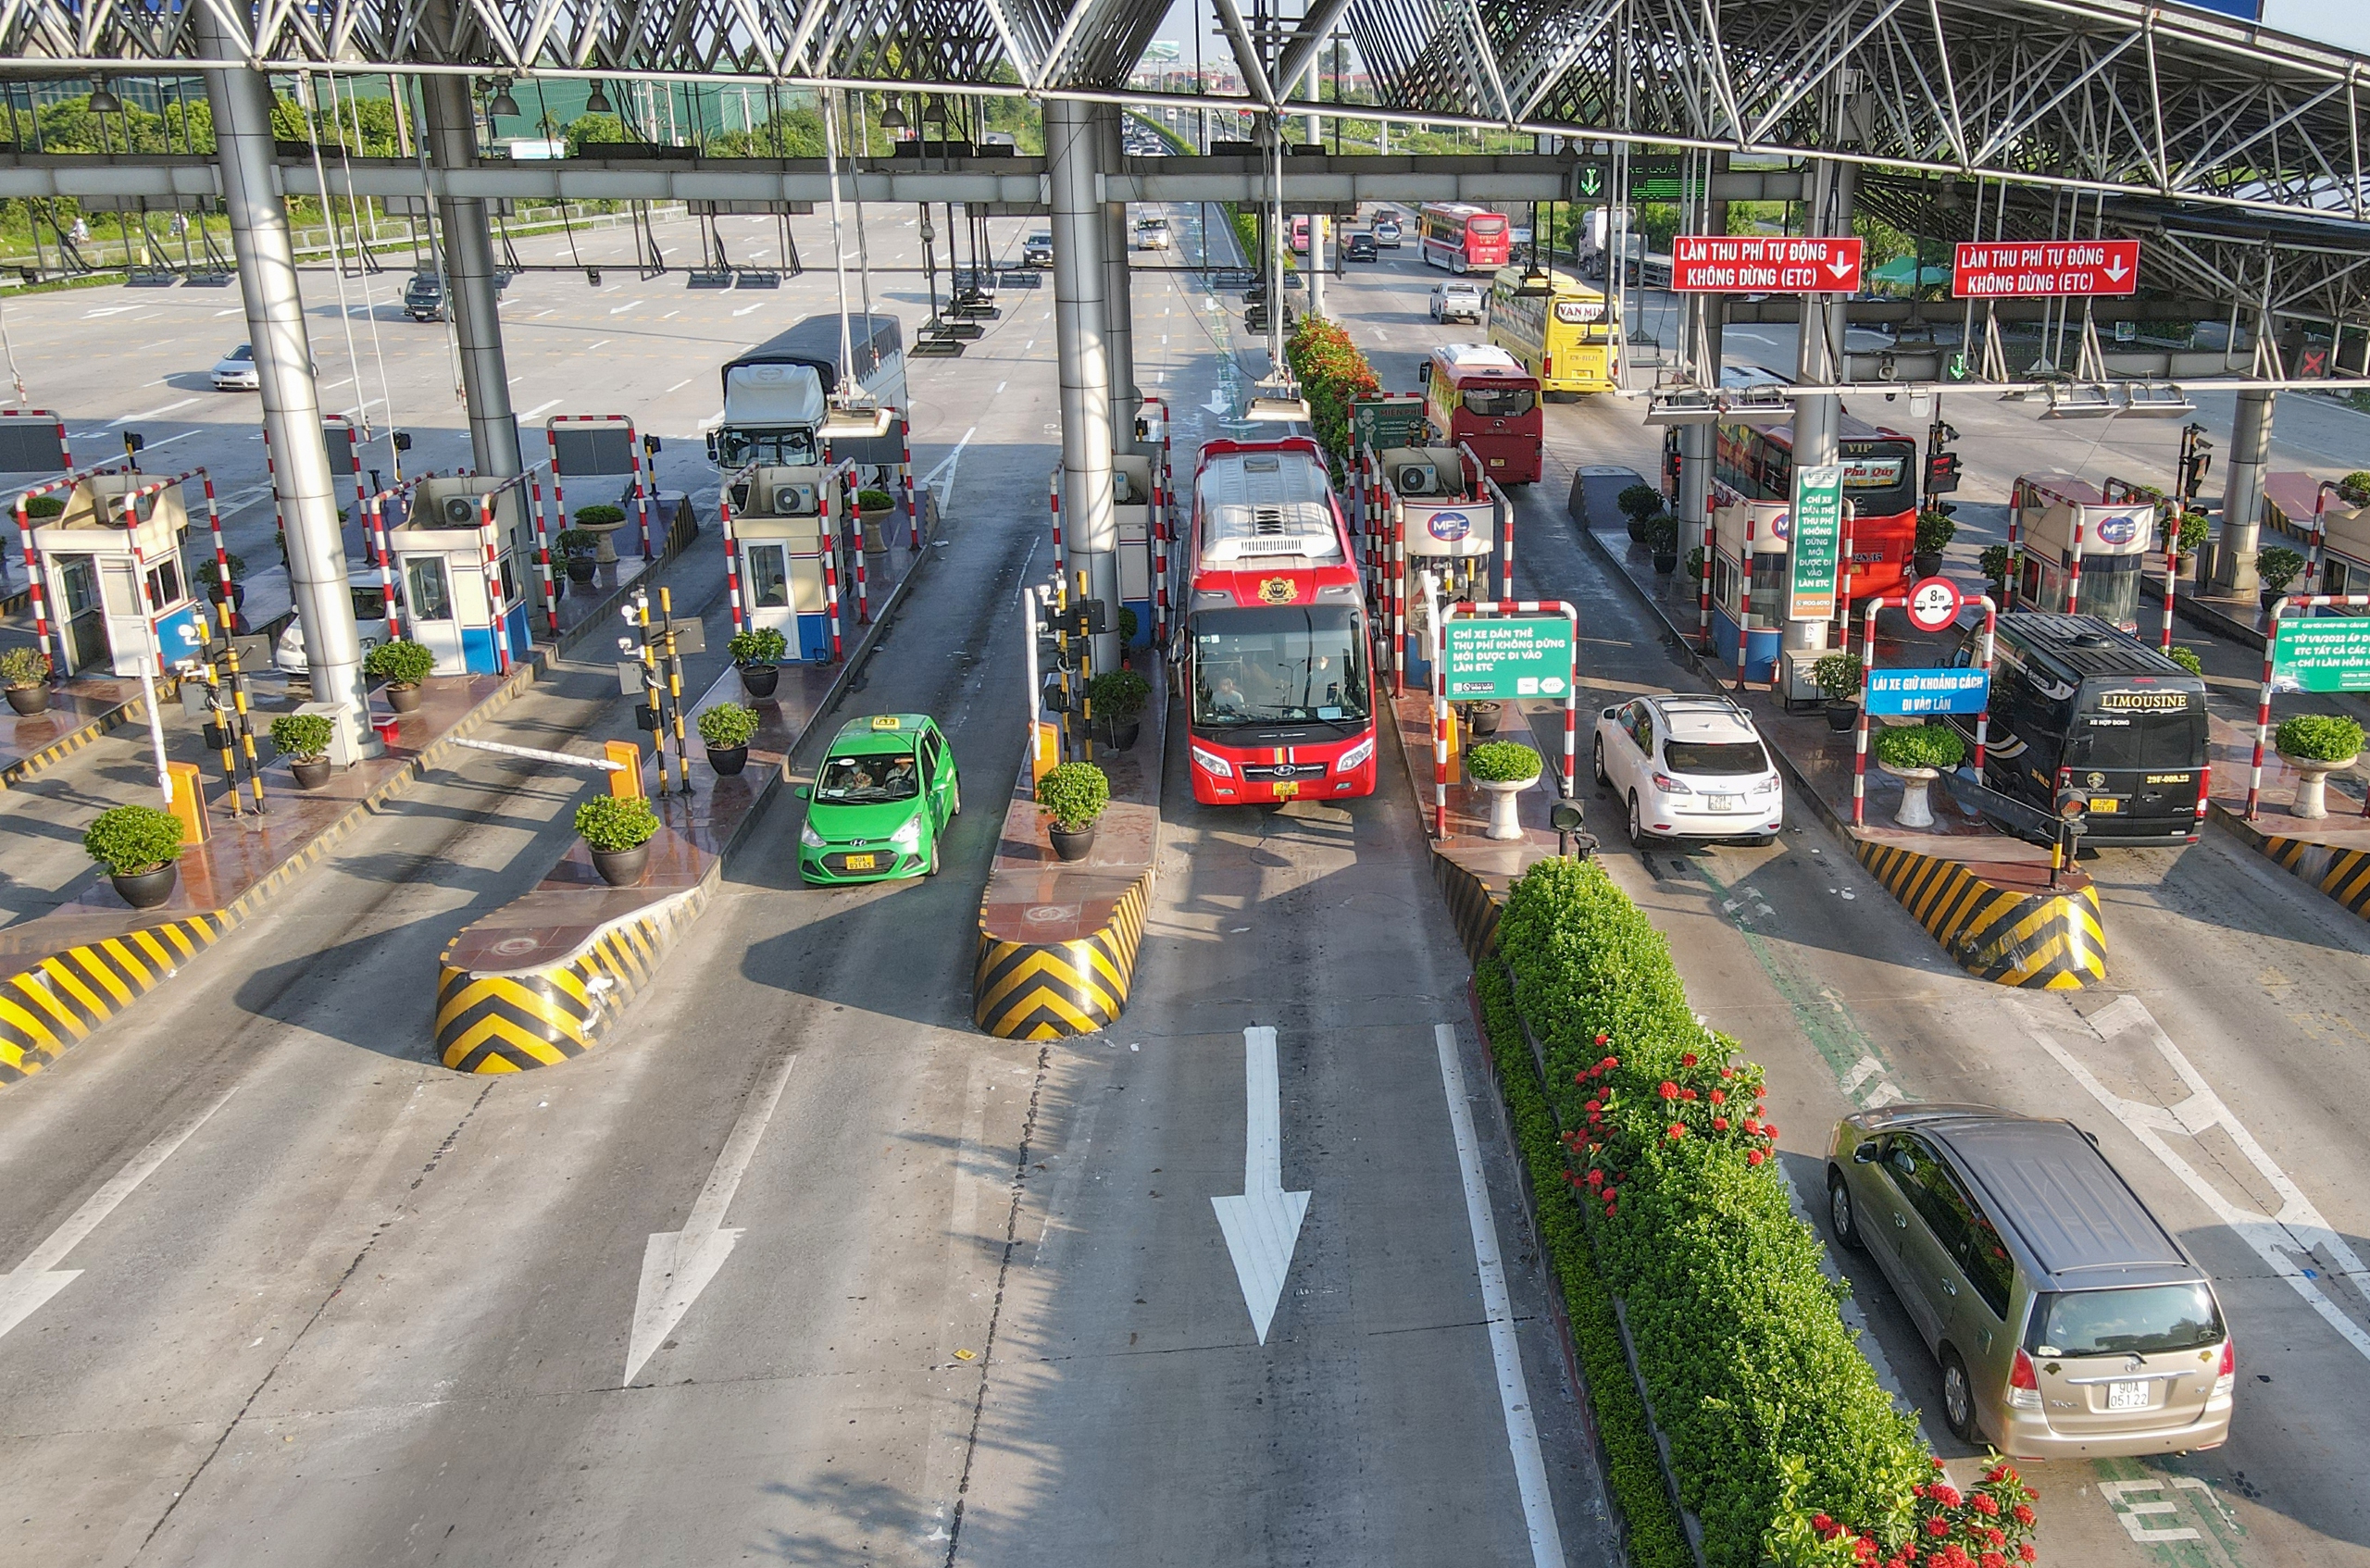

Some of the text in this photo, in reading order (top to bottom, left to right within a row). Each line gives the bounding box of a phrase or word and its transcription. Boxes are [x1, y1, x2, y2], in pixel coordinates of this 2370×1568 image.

[1680, 238, 1827, 264] LÀN THU PHÍ TỰ ĐỘNG
[1961, 245, 2104, 269] LÀN THU PHÍ TỰ ĐỘNG
[1687, 265, 1816, 287] KHÔNG DỪNG (ETC)
[1968, 270, 2093, 293] KHÔNG DỪNG (ETC)
[1584, 307, 1605, 317] MIN
[1848, 443, 1873, 453] VIP
[1433, 519, 1466, 530] MPC
[1820, 516, 1834, 525] PHÍ
[1802, 527, 1832, 535] KHÔNG
[2103, 524, 2134, 535] MPC
[1798, 579, 1829, 588] LÀN ETC
[1930, 590, 1937, 602] 8
[1474, 630, 1487, 639] XE
[2309, 635, 2345, 643] 1/8/2022
[2347, 632, 2360, 642] ÁP
[1453, 641, 1474, 650] THU
[1477, 640, 1494, 650] PHÍ
[1496, 639, 1533, 649] KHÔNG
[2294, 647, 2312, 655] ETC
[2348, 645, 2366, 654] CÁC
[1453, 651, 1473, 661] MỚI
[1522, 650, 1542, 659] VÀO
[1453, 662, 1493, 672] LÀN ETC
[2322, 657, 2339, 666] LÀN
[1873, 676, 1887, 691] LÁI
[1890, 678, 1901, 690] XE
[1920, 673, 1957, 690] KHOẢNG
[1959, 673, 1983, 689] CÁCH
[1915, 695, 1931, 710] VÀO
[2102, 695, 2187, 707] LIMOUSINE
[2119, 1382, 2139, 1394] 90A
[2110, 1394, 2147, 1407] 051.22
